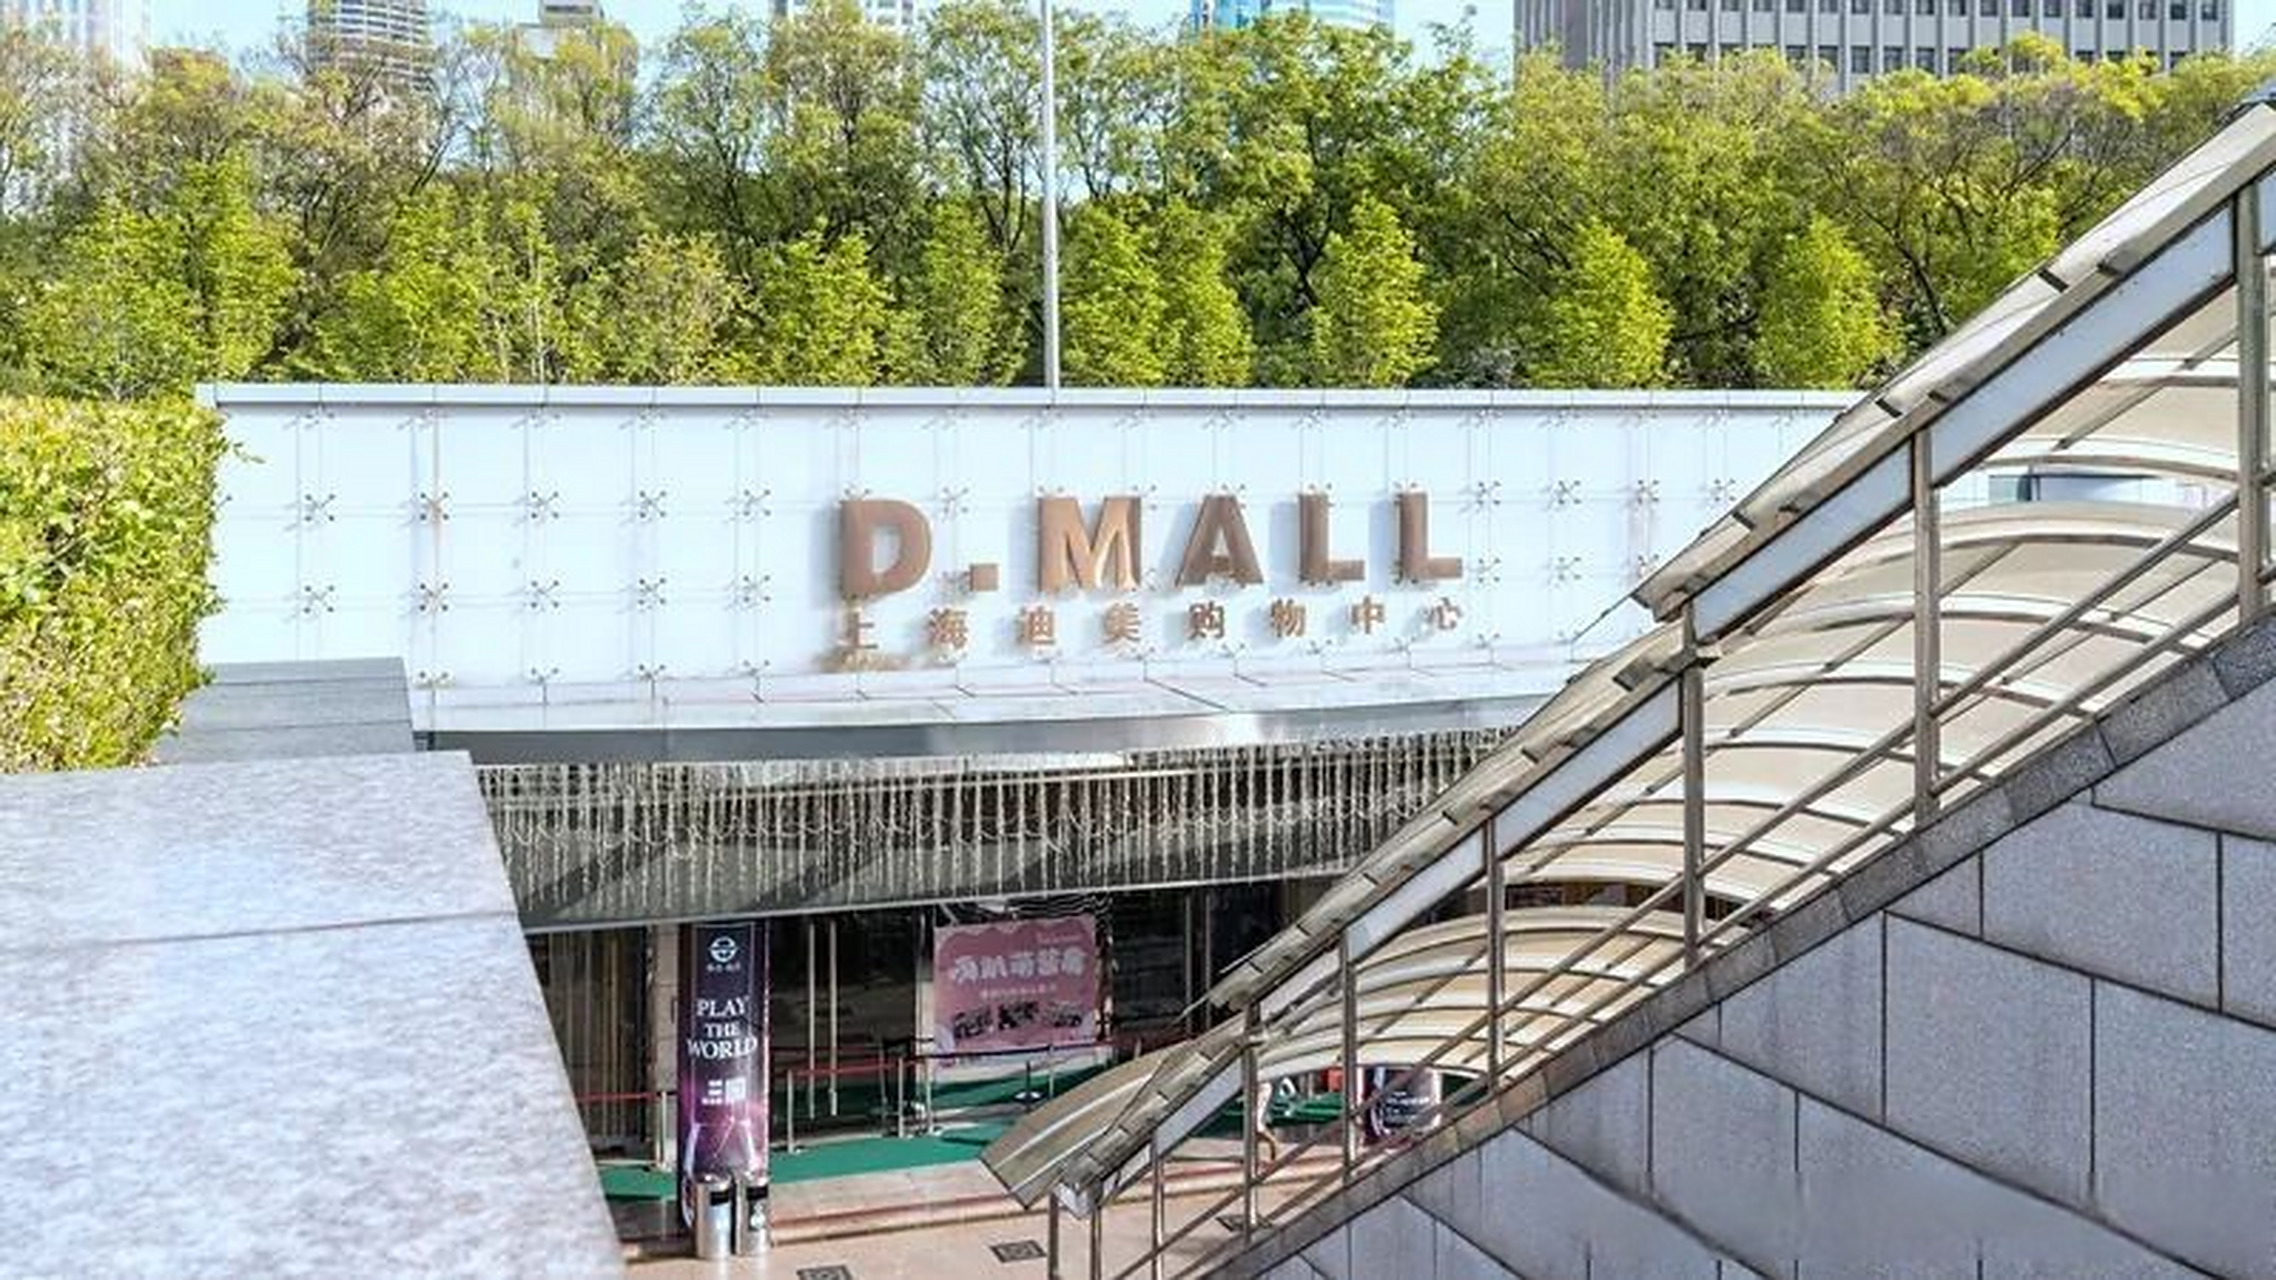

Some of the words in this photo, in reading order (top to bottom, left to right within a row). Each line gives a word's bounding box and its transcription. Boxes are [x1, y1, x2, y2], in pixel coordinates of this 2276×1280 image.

[837, 597, 1460, 648] 上海迪美购物中心
[696, 996, 749, 1017] PLAY
[704, 1021, 741, 1038] THE
[686, 1036, 758, 1060] WORLD
